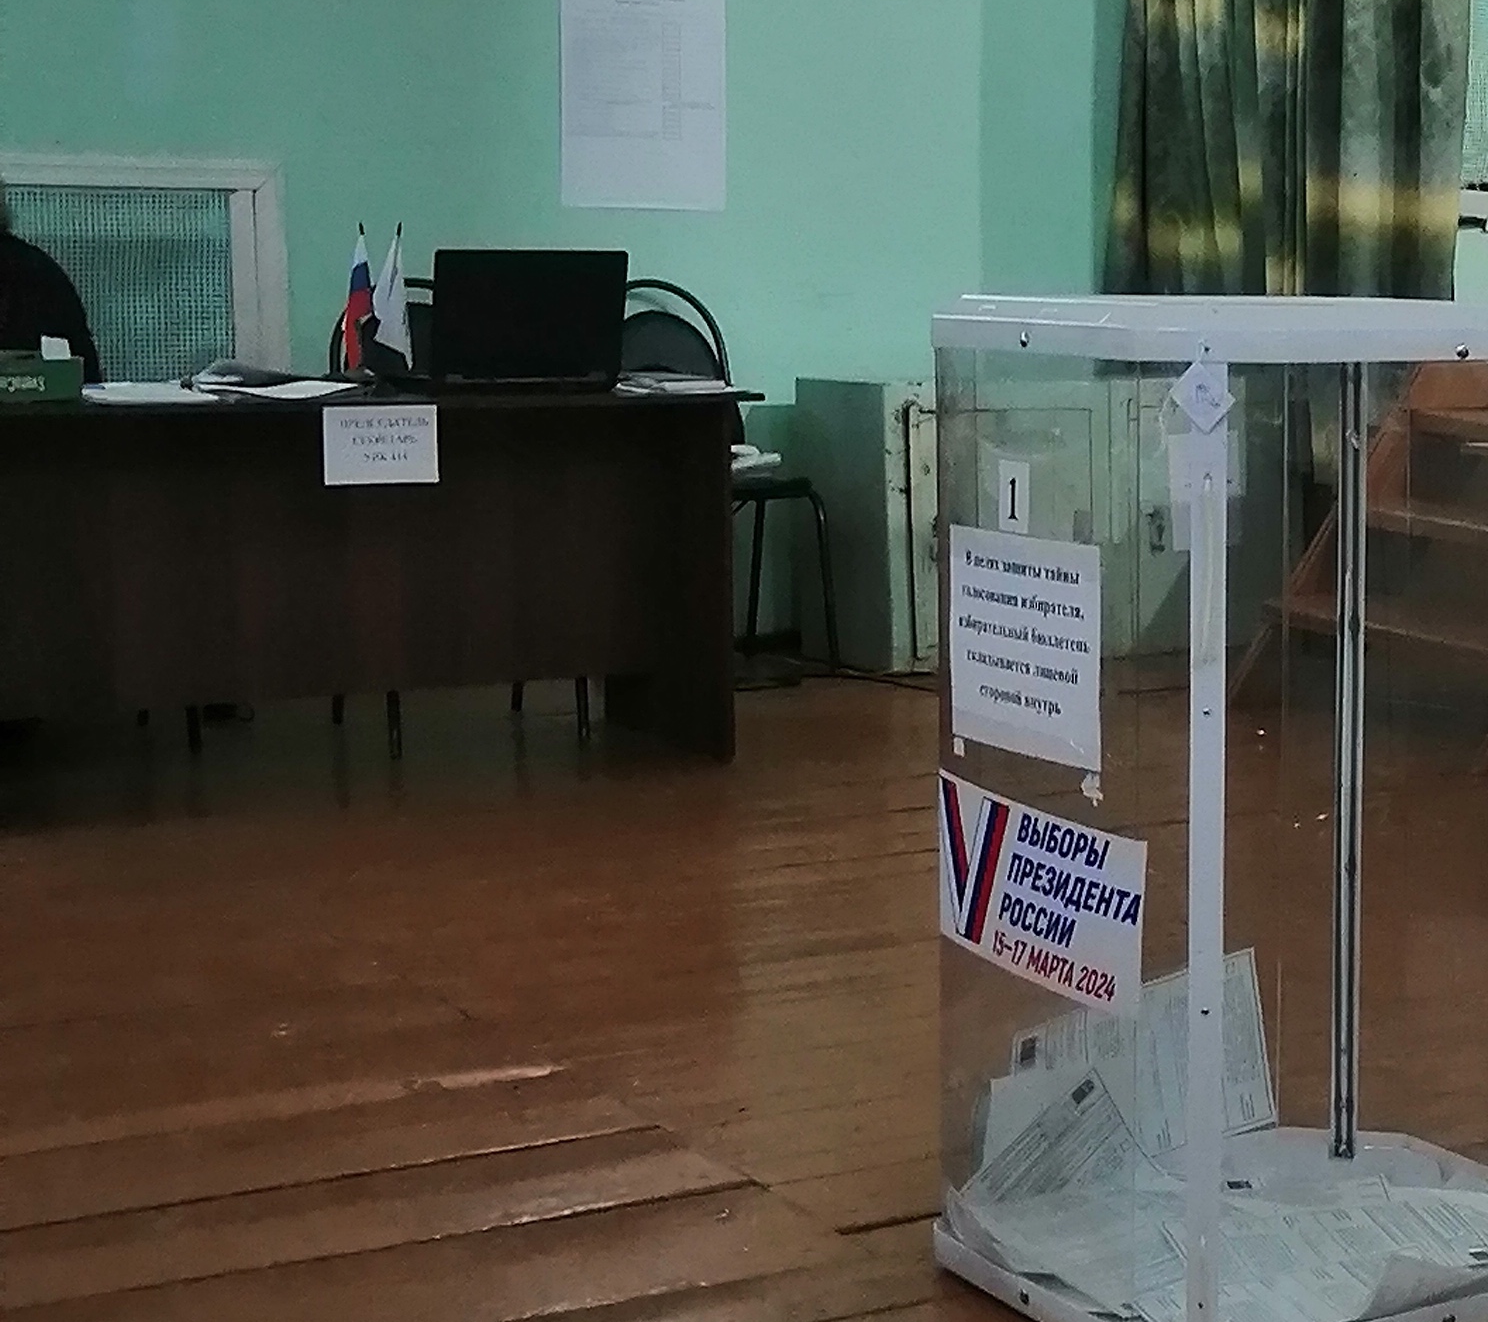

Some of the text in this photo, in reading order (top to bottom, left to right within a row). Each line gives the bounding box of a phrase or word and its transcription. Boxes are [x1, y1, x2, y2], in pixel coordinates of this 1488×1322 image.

[1008, 477, 1019, 521] 1
[965, 549, 1080, 585] В целях защиты тайны
[961, 584, 1085, 621] голосования избирателя,
[958, 614, 1090, 654] избирательный бюллетень
[966, 649, 1079, 685] складывается лицевой
[979, 684, 1062, 718] стороной внутрь
[1016, 812, 1110, 870] ВЫБОРЫ
[1007, 853, 1142, 926] ПРЕЗИДЕНТА
[998, 892, 1077, 948] РОССИИ
[1026, 948, 1076, 988] МАРТА
[1075, 965, 1116, 1001] 2024
